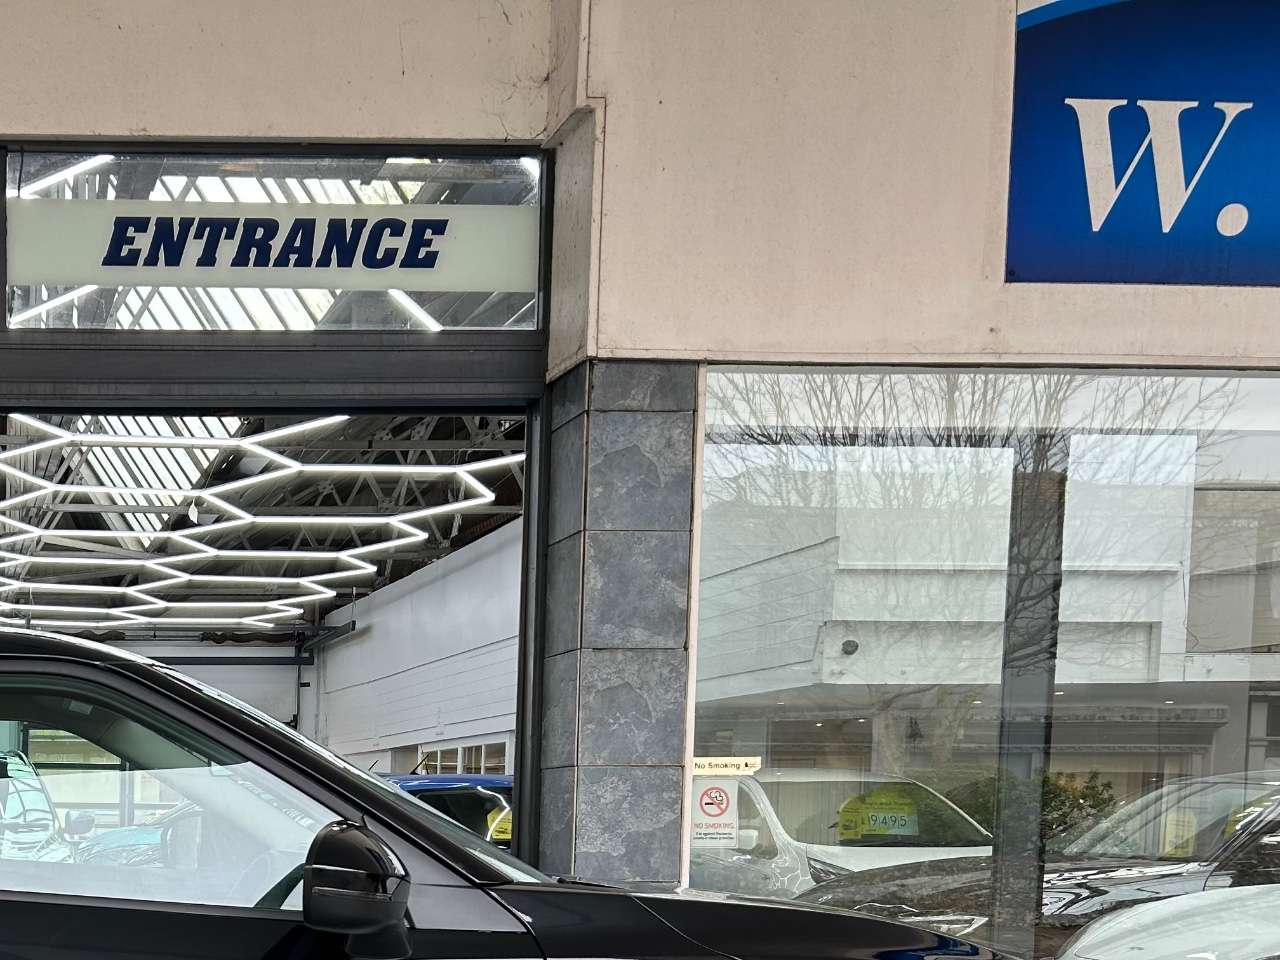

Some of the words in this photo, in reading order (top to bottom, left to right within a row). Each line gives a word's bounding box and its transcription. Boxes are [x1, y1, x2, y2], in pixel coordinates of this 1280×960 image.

[1064, 97, 1254, 238] W.
[101, 216, 450, 270] ENTRANCE
[694, 762, 706, 770] No
[707, 762, 741, 770] Smoking
[704, 822, 735, 830] SMOKING
